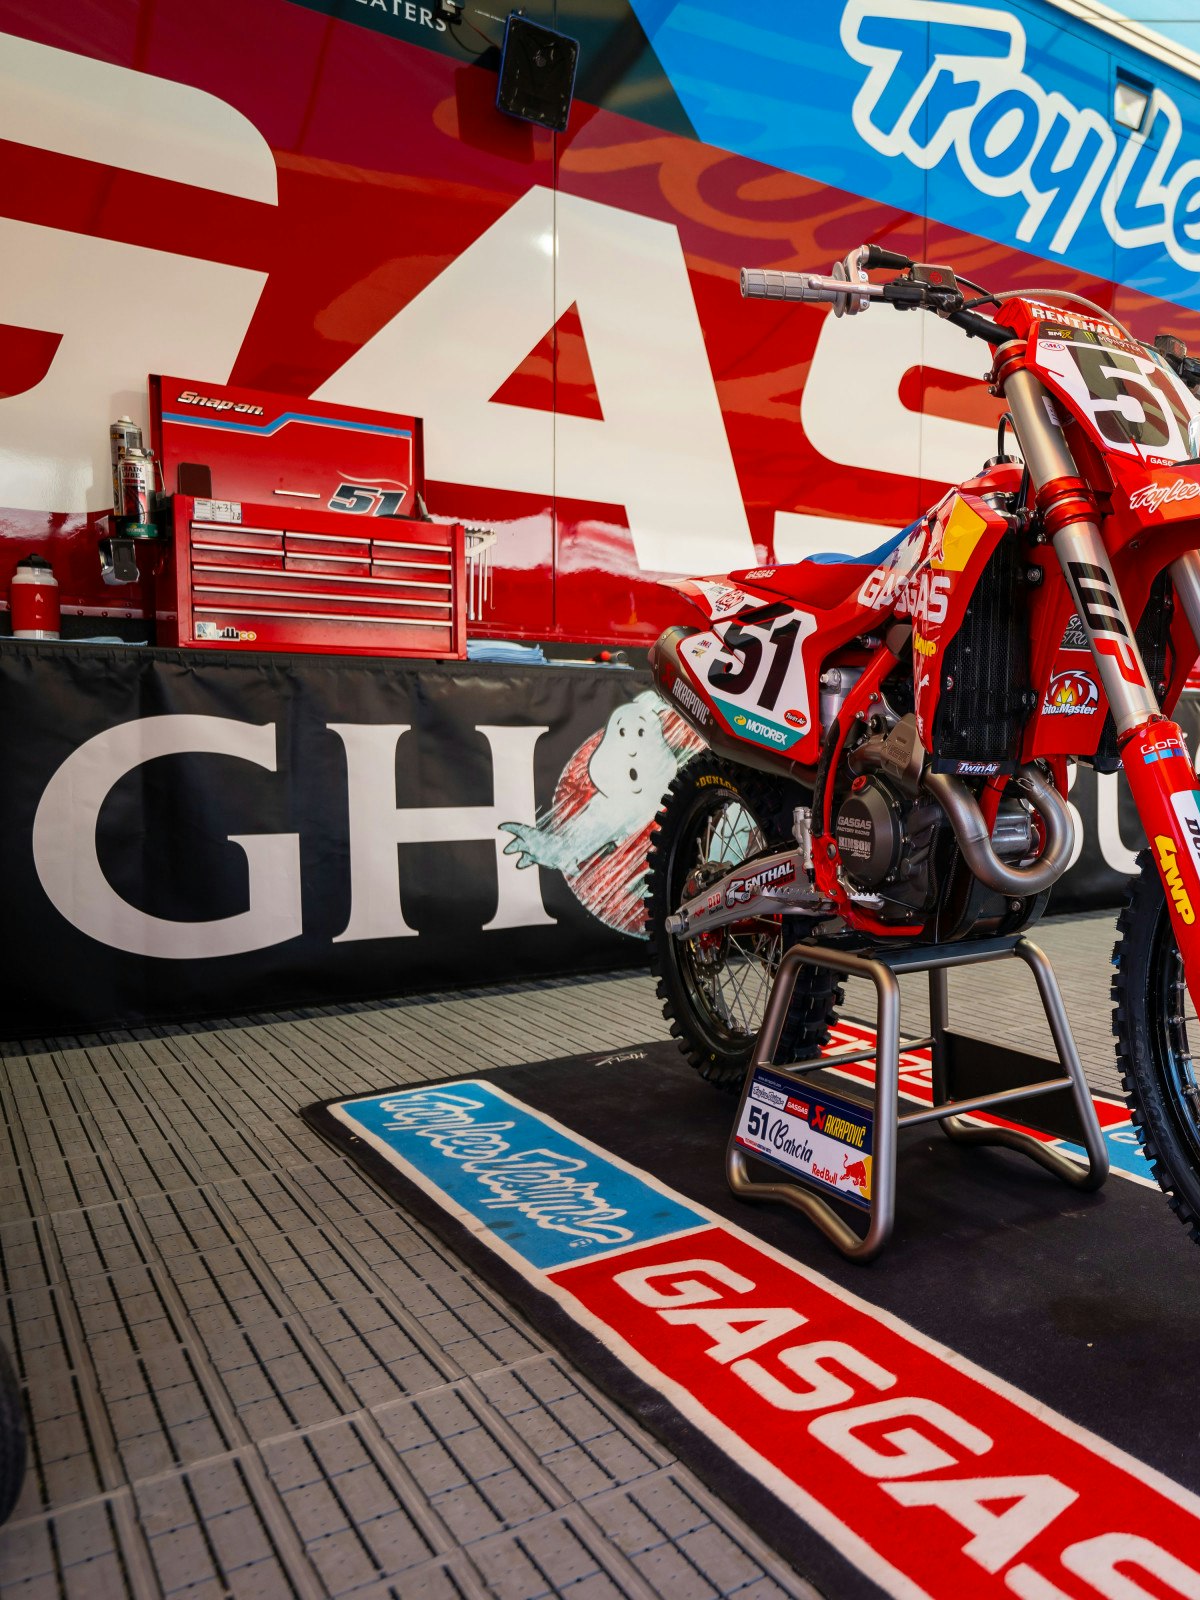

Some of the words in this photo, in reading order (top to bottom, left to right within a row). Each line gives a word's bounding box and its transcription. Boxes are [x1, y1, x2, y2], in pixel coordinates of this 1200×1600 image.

[1031, 306, 1122, 338] RENTHAL
[1065, 345, 1192, 458] 51
[327, 482, 407, 517] 51
[1130, 484, 1166, 513] Troy
[1164, 479, 1200, 503] Lee
[857, 569, 951, 624] GASGAS
[708, 603, 802, 713] 51
[746, 719, 788, 745] MOTOREX
[959, 763, 985, 772] Twin
[984, 763, 998, 772] Air
[838, 816, 872, 830] GASGAS
[747, 1105, 770, 1141] 51
[768, 1118, 814, 1164] Barcia
[811, 1162, 826, 1178] Red
[823, 1169, 839, 1186] Bull
